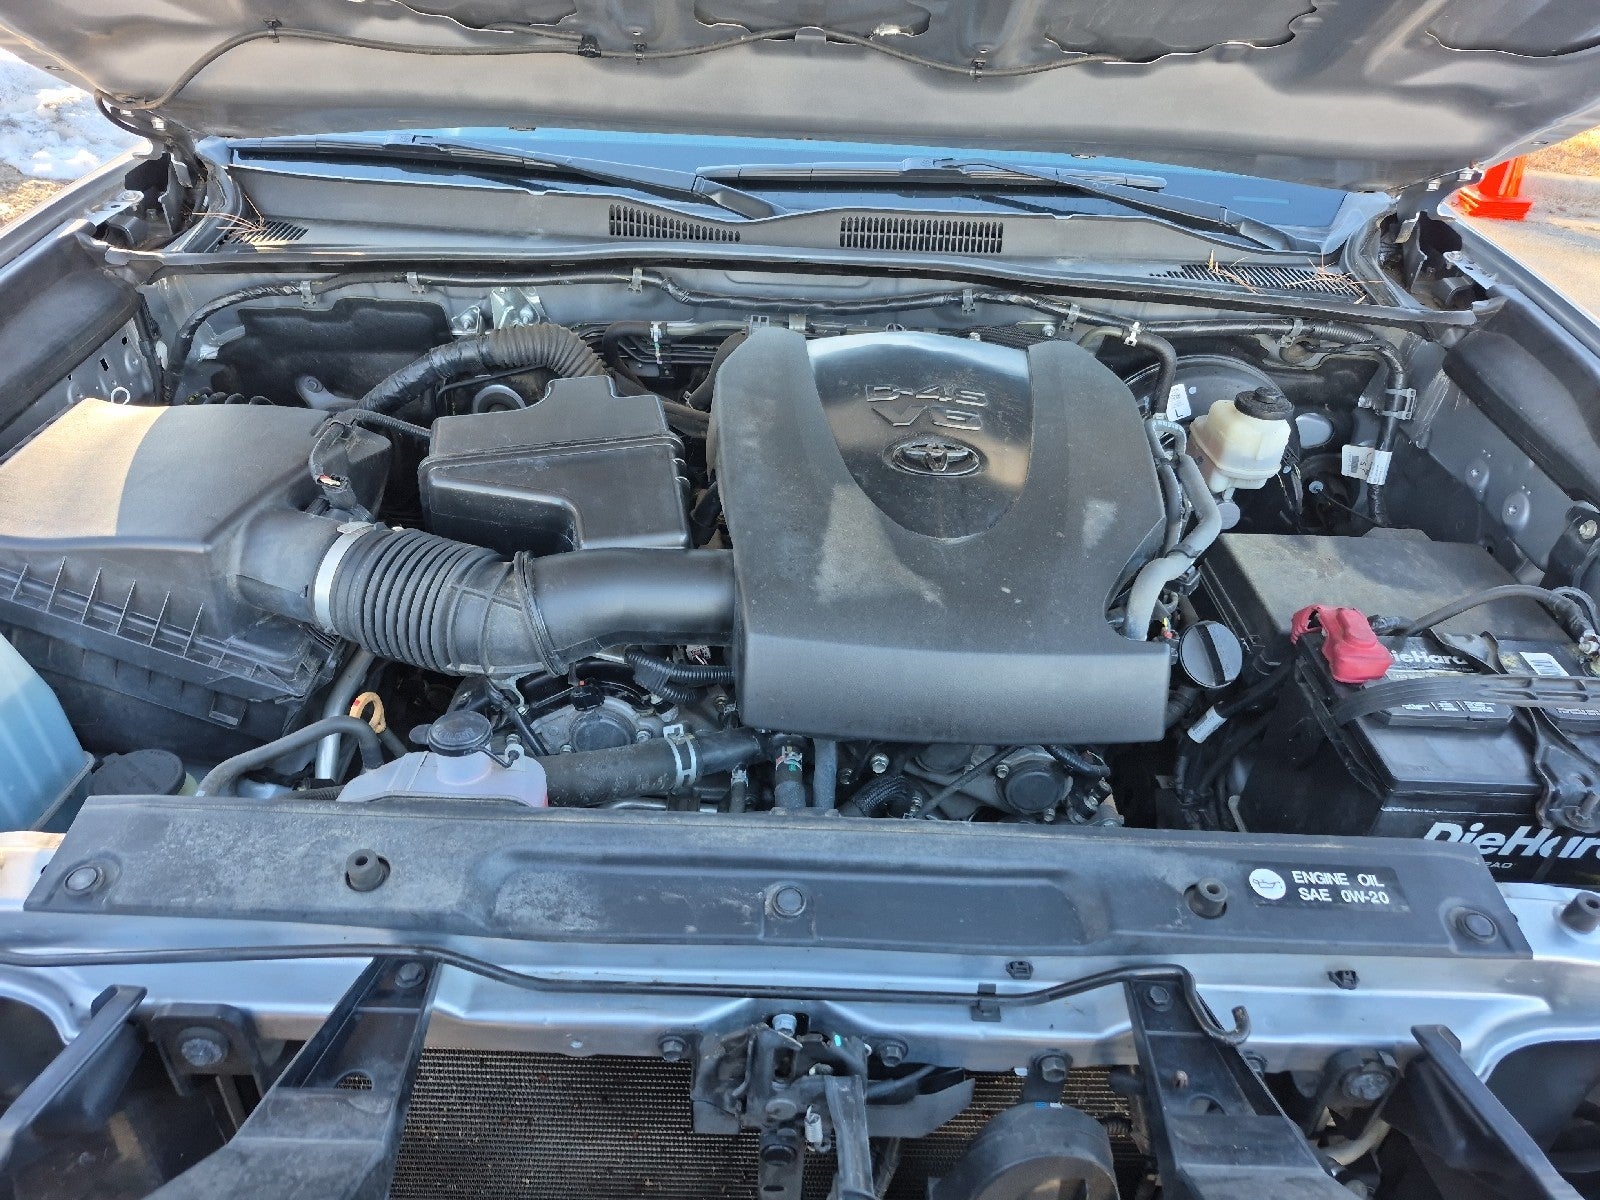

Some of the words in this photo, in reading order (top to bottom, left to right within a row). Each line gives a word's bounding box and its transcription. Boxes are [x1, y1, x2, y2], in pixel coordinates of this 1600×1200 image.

[871, 404, 983, 432] V6
[1391, 649, 1469, 666] ieHar
[1423, 821, 1600, 860] DieHar
[1291, 870, 1350, 886] ENGINE
[1356, 873, 1386, 887] OIL
[1298, 888, 1333, 902] SAE
[1340, 889, 1390, 905] 0W-20
